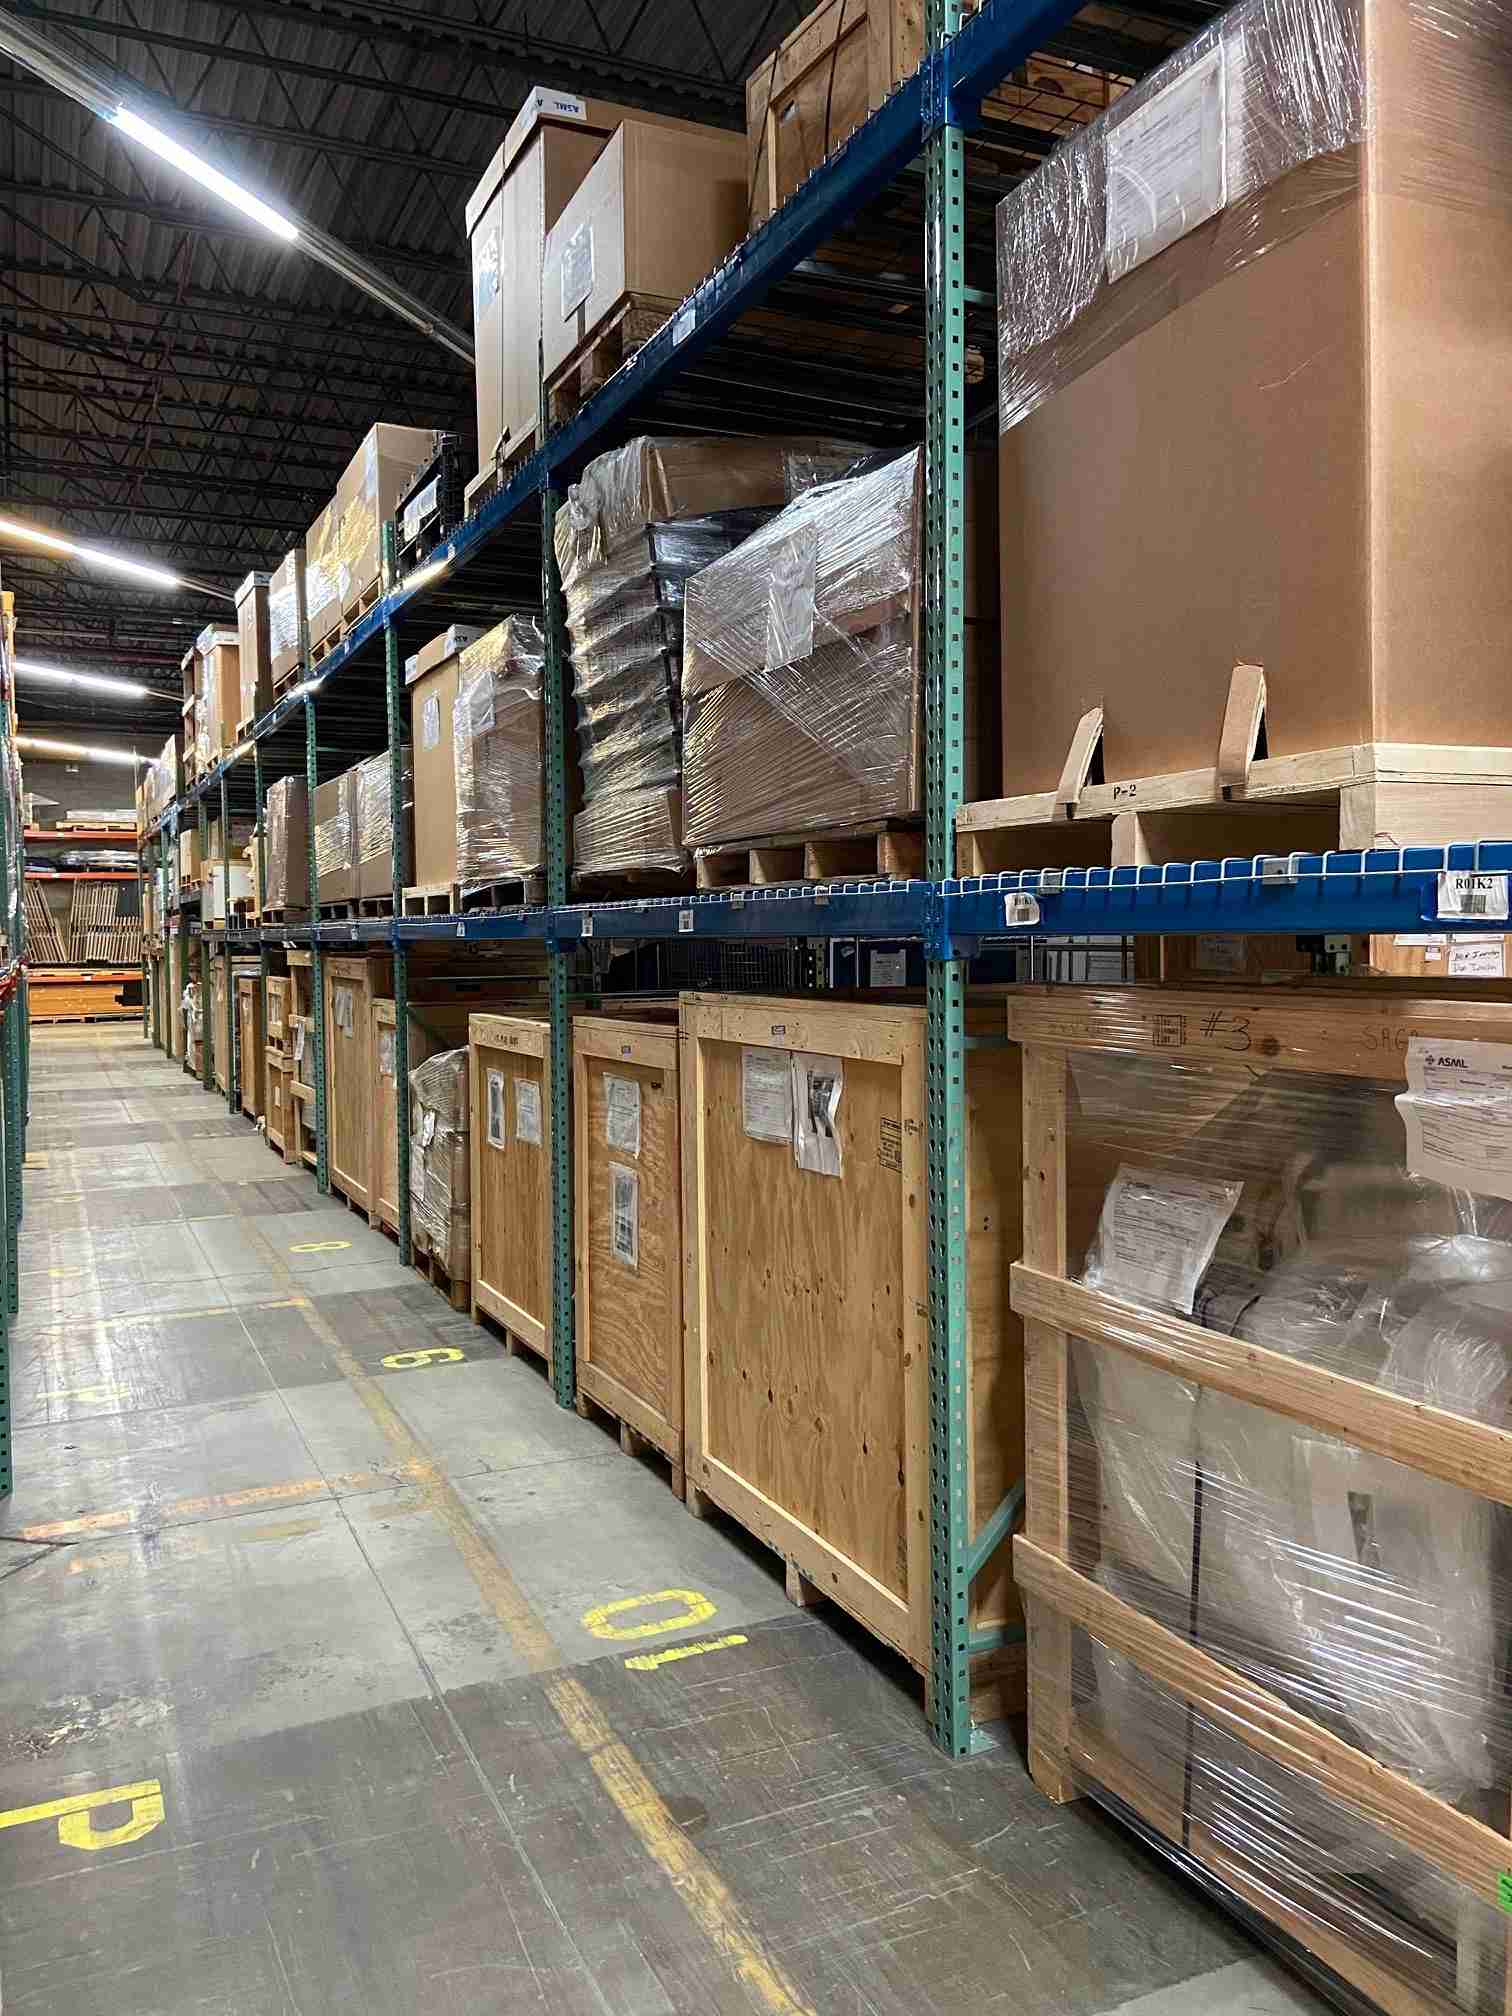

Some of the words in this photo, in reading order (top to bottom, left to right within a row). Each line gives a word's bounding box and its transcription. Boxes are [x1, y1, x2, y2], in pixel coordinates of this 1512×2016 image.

[1113, 784, 1137, 800] P-2
[1455, 878, 1493, 889] R01K2
[1200, 1010, 1252, 1051] #3
[1438, 1057, 1469, 1069] ASML
